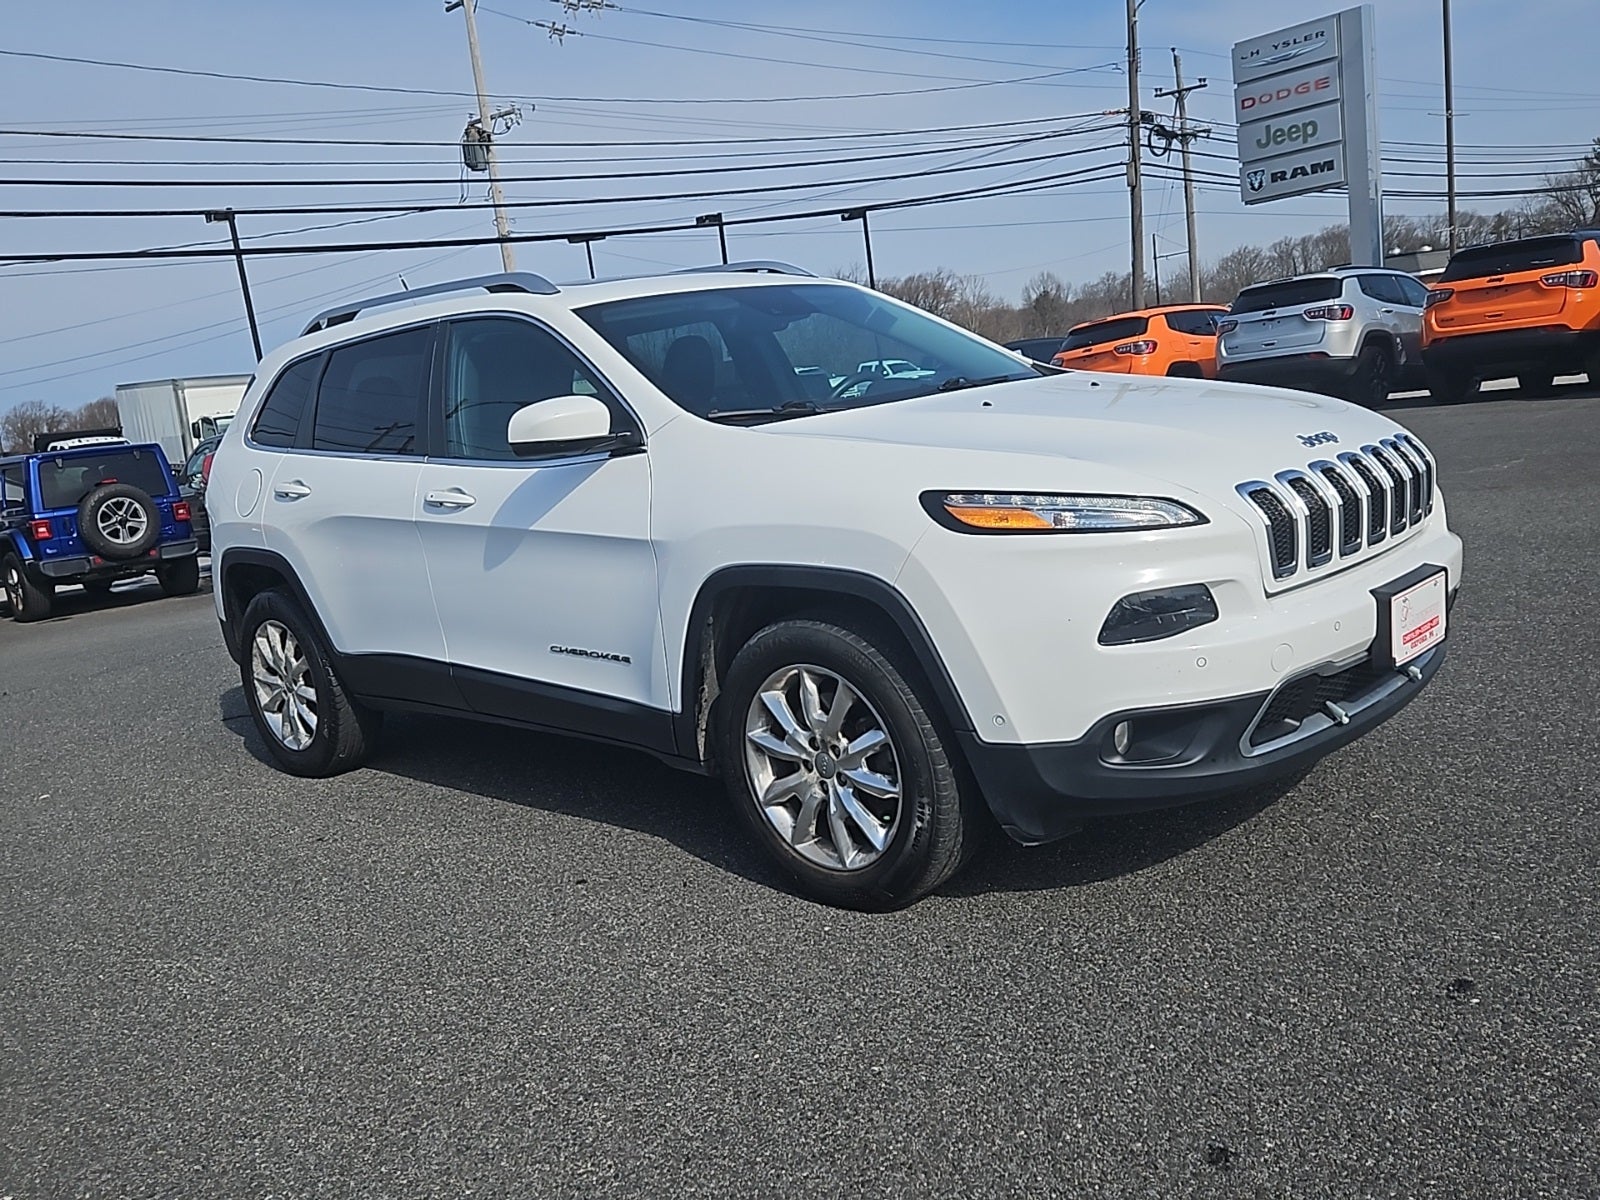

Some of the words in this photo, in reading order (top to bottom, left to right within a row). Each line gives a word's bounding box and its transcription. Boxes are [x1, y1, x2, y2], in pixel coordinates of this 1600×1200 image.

[1240, 30, 1326, 60] HYSLER
[1241, 76, 1331, 110] DODGE
[1256, 119, 1318, 149] Jeep
[1270, 159, 1335, 183] RAM
[1296, 431, 1340, 448] Jeep
[549, 645, 632, 665] CHEROKEE
